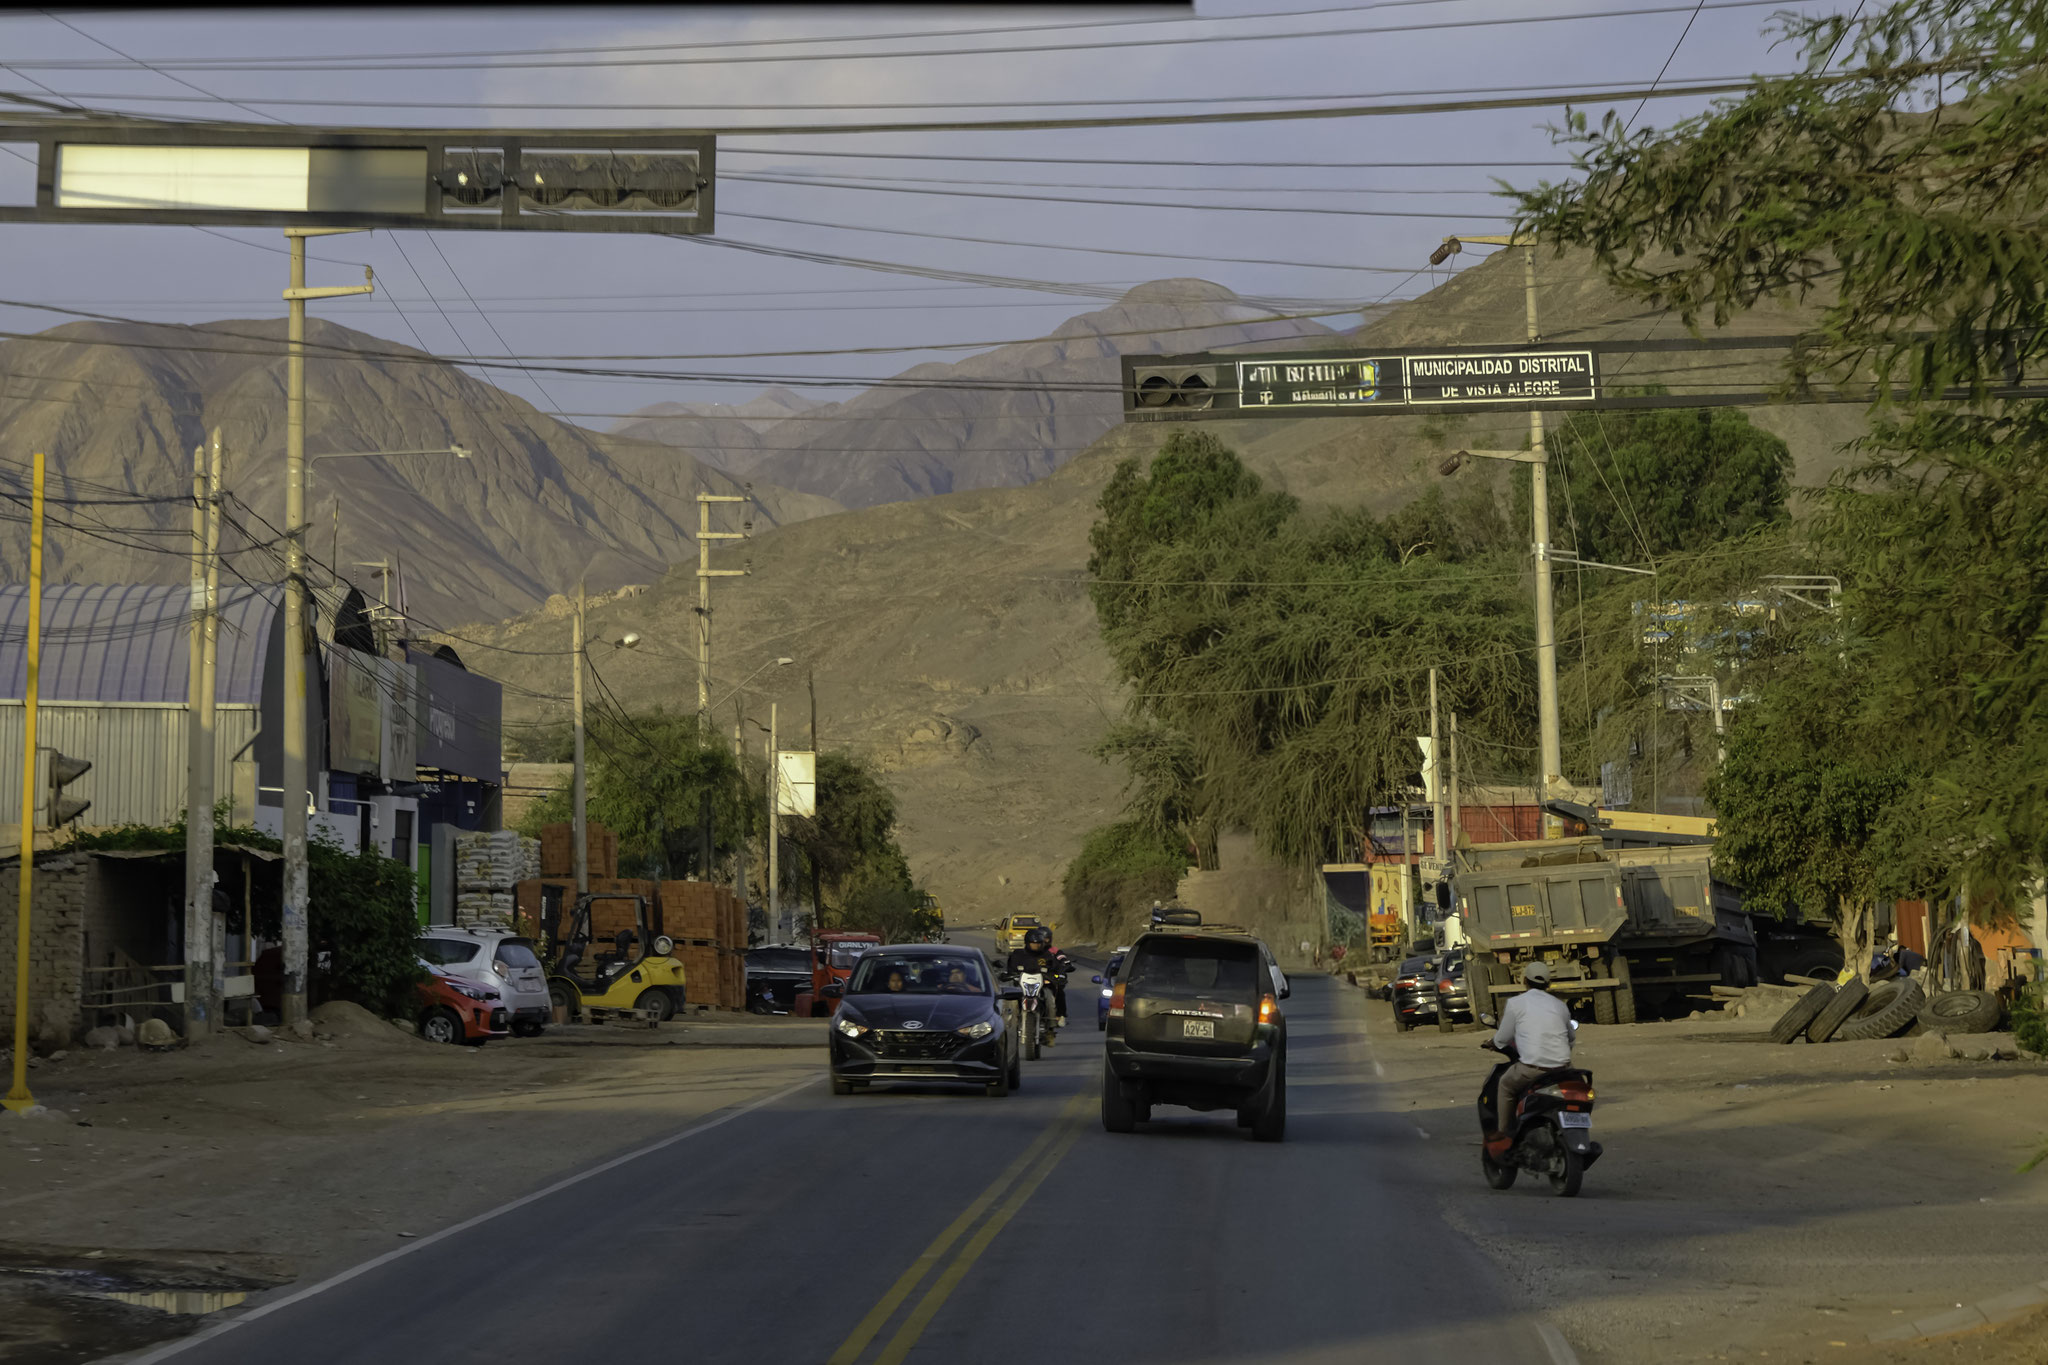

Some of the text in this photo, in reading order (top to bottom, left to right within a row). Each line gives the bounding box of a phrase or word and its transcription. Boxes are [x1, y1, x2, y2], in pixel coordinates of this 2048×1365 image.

[1413, 357, 1585, 376] MUNICIPALIDAD DISTRITAL
[1441, 380, 1561, 398] DE VISTA ALEGRE
